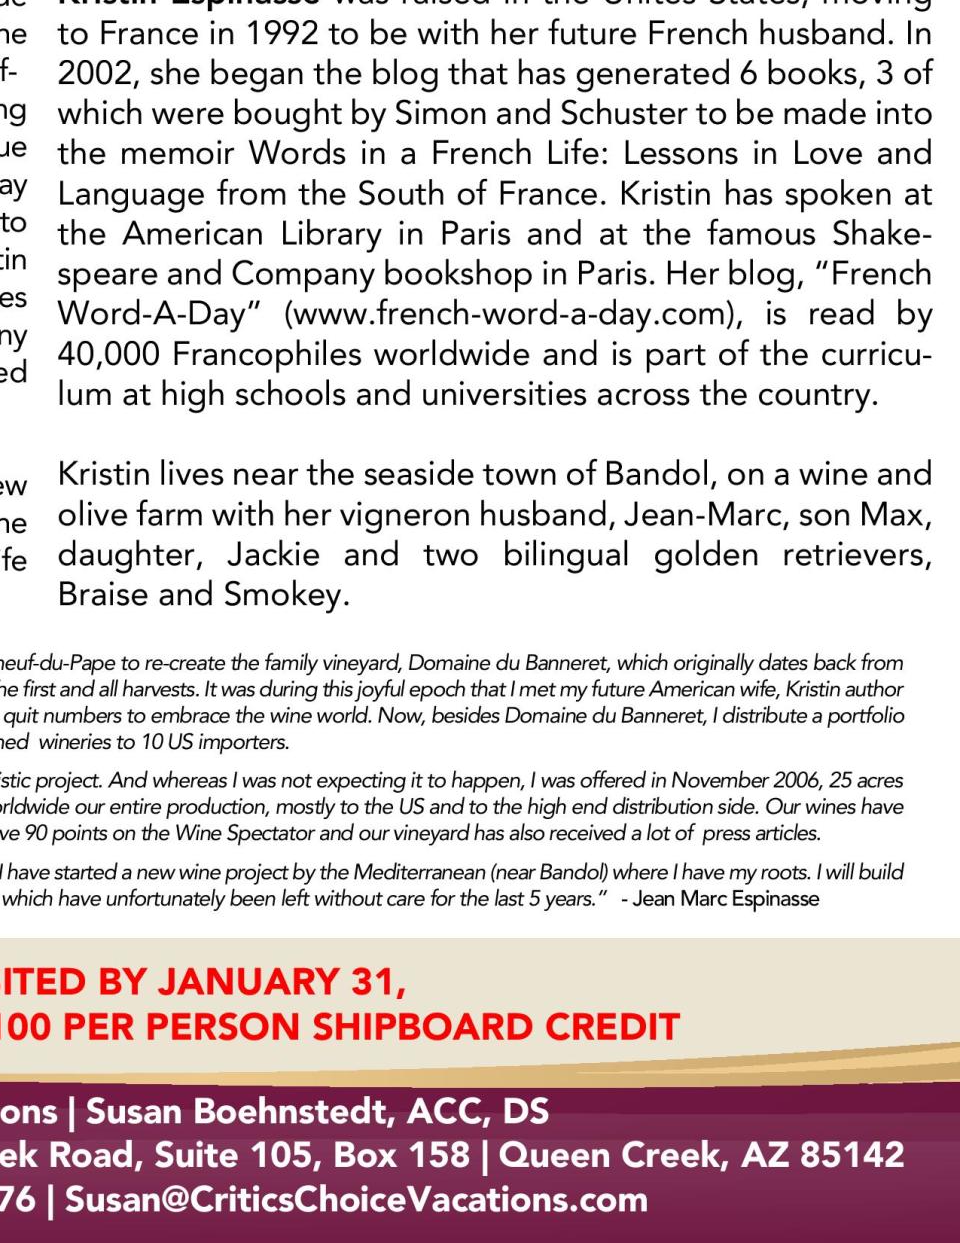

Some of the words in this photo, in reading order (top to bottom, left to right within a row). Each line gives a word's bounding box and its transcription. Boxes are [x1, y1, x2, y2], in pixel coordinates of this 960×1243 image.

[285, 297, 743, 333] (www.french-word-a-day.com),
[766, 300, 787, 326] is
[809, 298, 875, 326] read
[897, 298, 934, 334] by
[59, 580, 148, 607] Braise
[159, 579, 213, 607] and
[224, 579, 349, 614] Smokey.
[39, 732, 112, 750] wineries
[116, 735, 136, 750] to
[143, 732, 164, 750] 10
[168, 732, 194, 751] US
[198, 732, 289, 755] importers.
[99, 967, 148, 996] BY
[157, 967, 340, 996] JANUARY
[352, 967, 405, 999] 31,
[64, 1012, 134, 1041] PER
[147, 1012, 299, 1041] PERSON
[313, 1012, 533, 1041] SHIPBOARD
[545, 1012, 681, 1041] CREDIT
[86, 1096, 182, 1125] Susan
[194, 1095, 395, 1129] Boehnstedt,
[406, 1096, 491, 1129] ACC,
[504, 1096, 549, 1125] DS
[50, 1139, 143, 1172] Road,
[154, 1140, 239, 1169] Suite
[251, 1140, 321, 1172] 105,
[334, 1140, 398, 1168] Box
[409, 1140, 470, 1168] 158
[499, 1140, 610, 1168] Queen
[622, 1139, 729, 1172] Creek,
[740, 1141, 790, 1168] AZ
[800, 1140, 905, 1168] 85142
[65, 1183, 648, 1213] Susan@CriticsChoiceVacations.com
